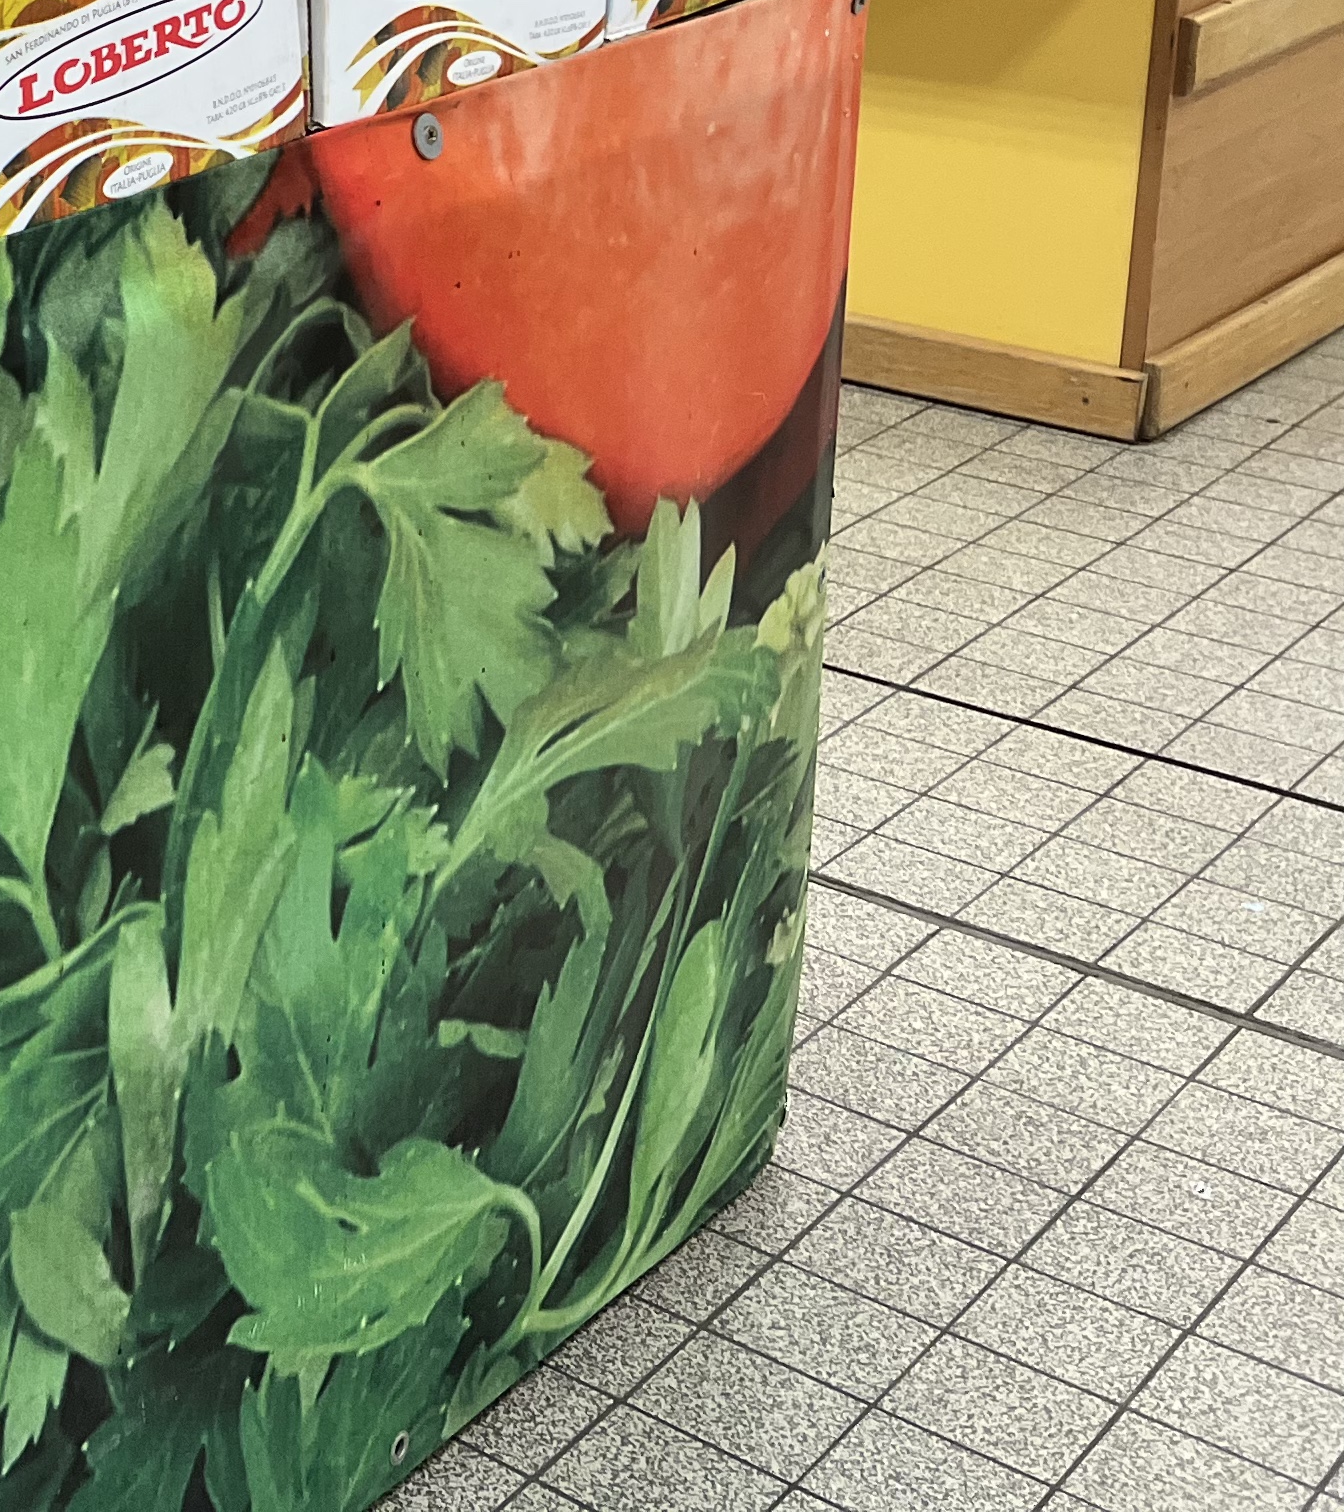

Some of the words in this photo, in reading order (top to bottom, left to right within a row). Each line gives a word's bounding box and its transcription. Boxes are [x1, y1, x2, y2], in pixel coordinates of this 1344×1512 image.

[5, 46, 23, 66] SAN
[24, 18, 79, 54] FERDINANDO
[81, 13, 90, 26] DI
[92, 0, 121, 20] PUGLIA
